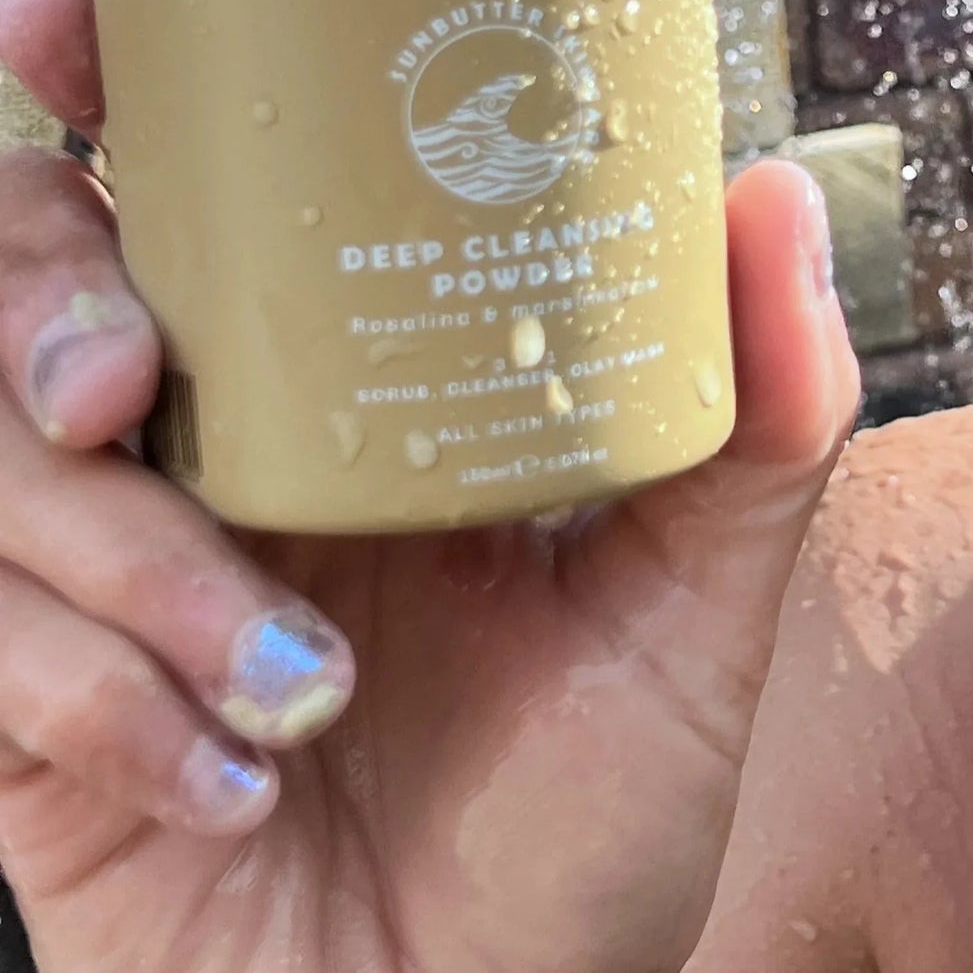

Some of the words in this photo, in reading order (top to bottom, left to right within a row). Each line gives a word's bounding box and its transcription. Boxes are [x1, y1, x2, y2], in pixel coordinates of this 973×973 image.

[388, 0, 544, 84] SUNBUTTER
[341, 240, 444, 271] DEEP
[431, 253, 594, 298] POWDER
[352, 312, 471, 334] Rosalina
[437, 423, 480, 444] ALL
[488, 415, 544, 437] SKIN
